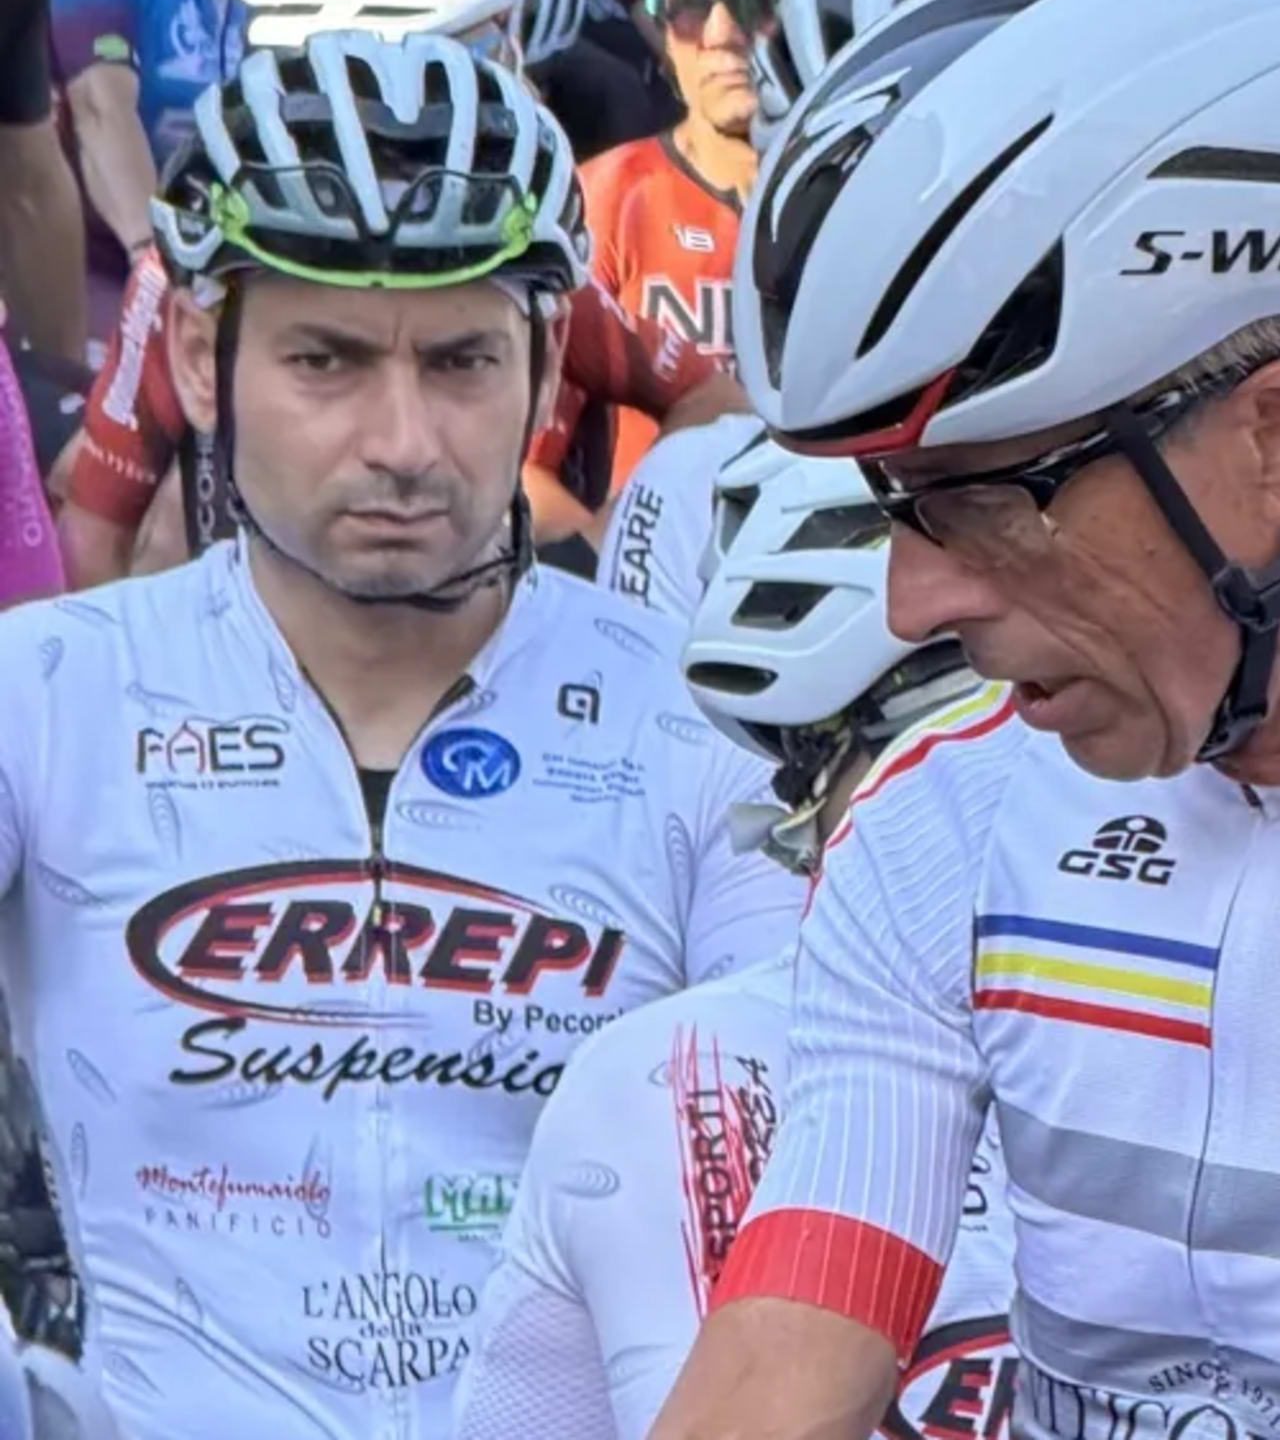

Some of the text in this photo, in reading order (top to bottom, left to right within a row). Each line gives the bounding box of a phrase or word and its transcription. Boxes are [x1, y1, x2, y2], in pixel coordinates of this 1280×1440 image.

[1057, 850, 1176, 886] GSG
[175, 900, 627, 997] ERREPI
[474, 999, 513, 1035] By
